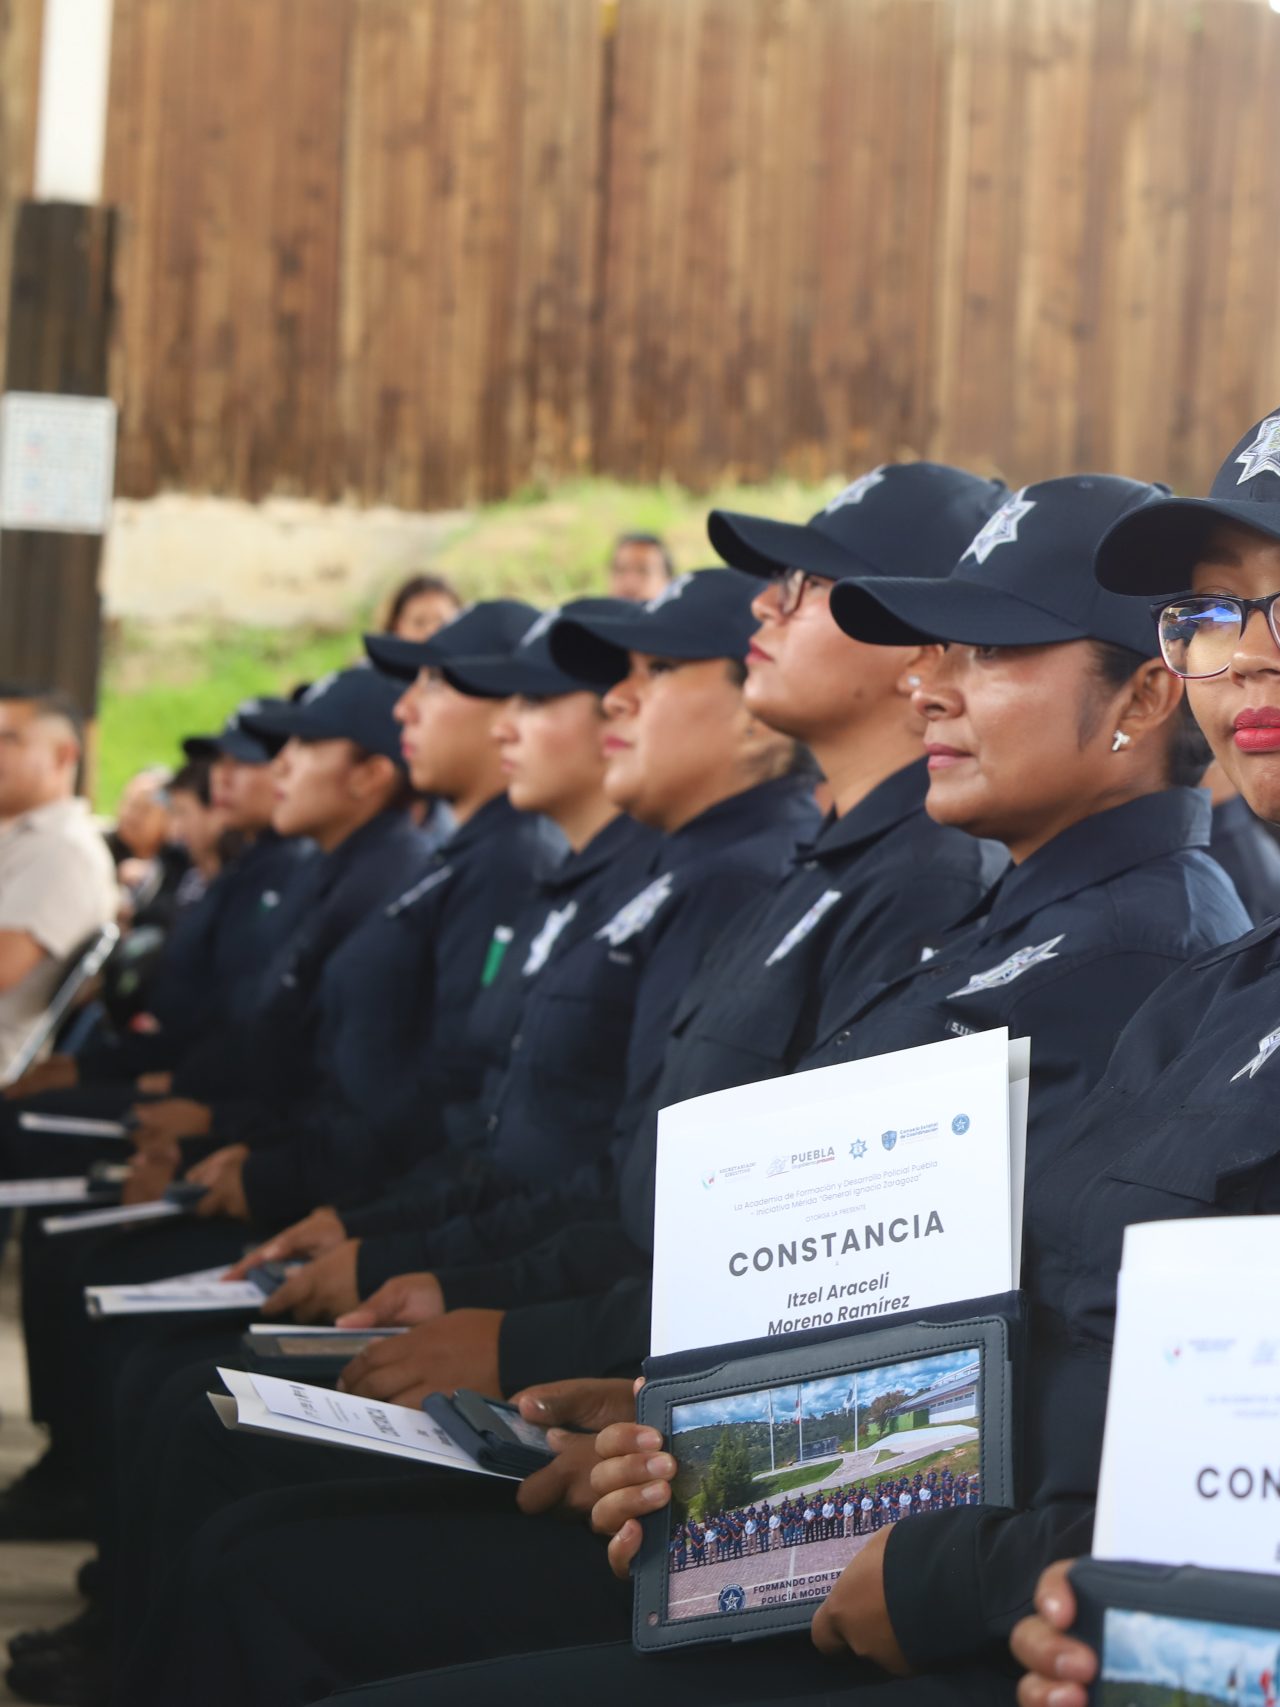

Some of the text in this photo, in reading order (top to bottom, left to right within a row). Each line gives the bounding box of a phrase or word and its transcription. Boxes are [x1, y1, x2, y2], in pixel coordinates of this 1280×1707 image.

[791, 1146, 835, 1164] PUEBLA
[734, 1203, 743, 1211] La
[745, 1195, 783, 1209] Academia
[784, 1192, 795, 1201] de
[796, 1183, 837, 1197] Formación
[844, 1173, 882, 1188] Desarrollo
[883, 1167, 910, 1179] Policial
[912, 1160, 938, 1171] Puebla
[756, 1203, 791, 1216] Iniciativa
[792, 1196, 818, 1208] Mérida
[853, 1183, 882, 1196] Ignacio
[729, 1210, 944, 1277] CONSTANCIA
[787, 1272, 890, 1308] Itzel Araceli
[768, 1295, 910, 1336] Moreno Ramírez
[753, 1577, 806, 1594] FORMANDO
[808, 1573, 828, 1584] CON
[761, 1590, 797, 1604] POLICÍA
